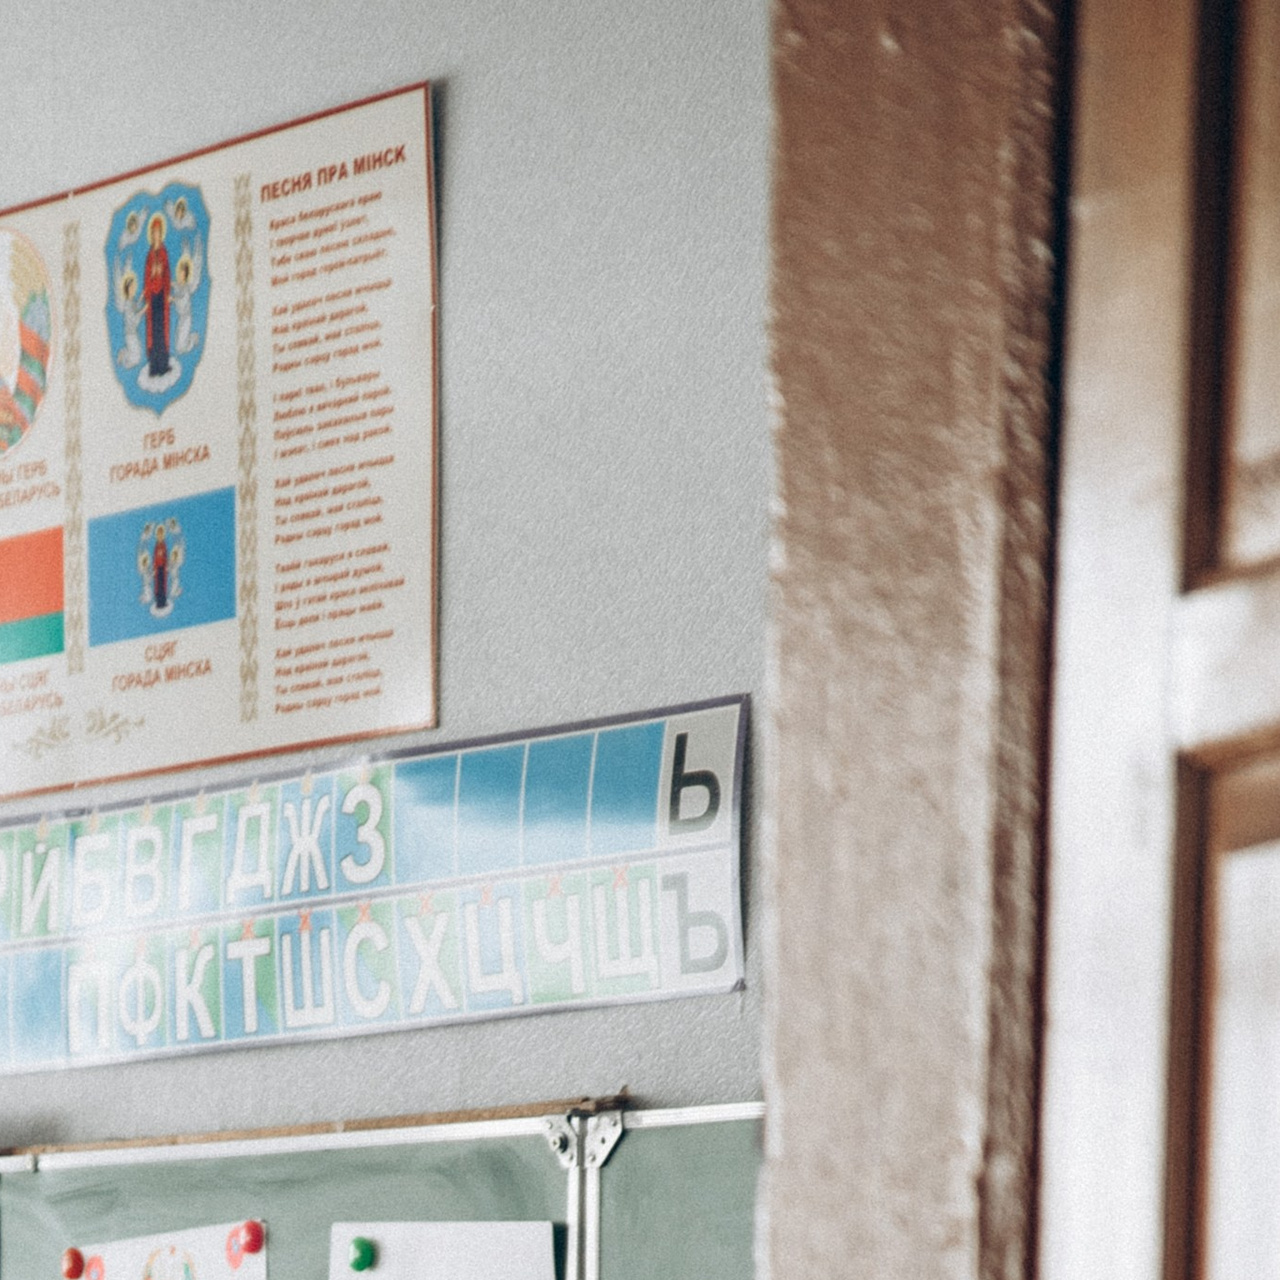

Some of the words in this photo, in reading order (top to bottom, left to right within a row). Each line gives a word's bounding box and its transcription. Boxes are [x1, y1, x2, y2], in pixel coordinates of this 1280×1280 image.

[260, 171, 312, 203] ПЕСНЯ
[317, 161, 348, 186] ПРА
[353, 144, 406, 175] МІНСК
[143, 428, 175, 450] ГЕРБ
[109, 456, 158, 483] ГОРАДА
[162, 444, 210, 470] МІНСКА
[112, 668, 160, 692] ГОРАДА
[164, 658, 212, 683] МІНСКА
